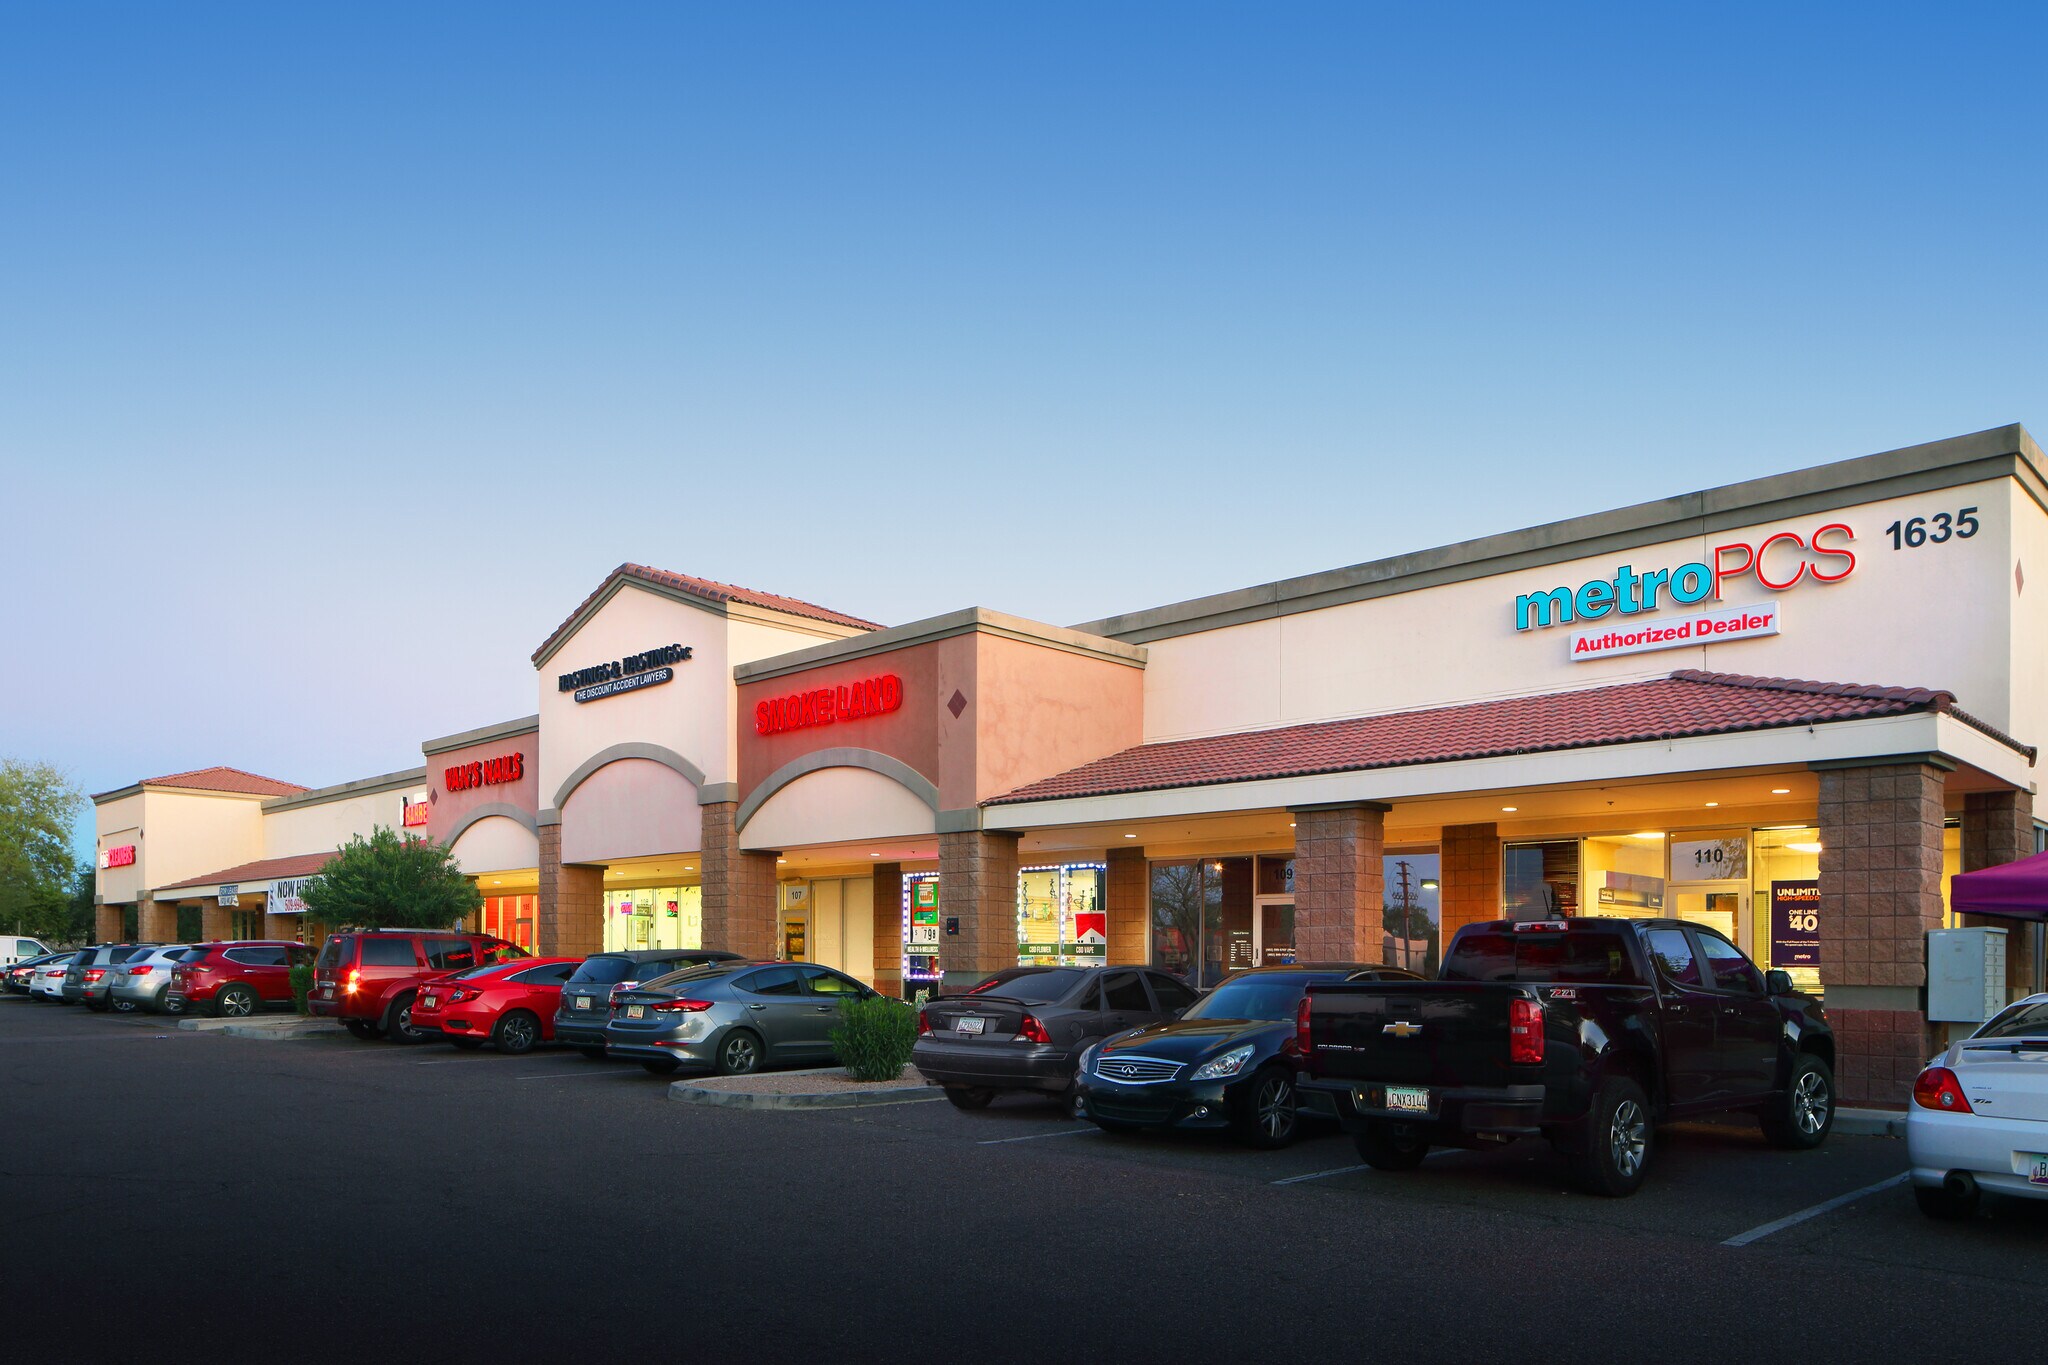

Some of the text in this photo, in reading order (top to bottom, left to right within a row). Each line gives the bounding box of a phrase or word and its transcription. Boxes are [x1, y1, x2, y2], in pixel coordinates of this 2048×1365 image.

[1886, 506, 1980, 550] 1635
[1516, 523, 1857, 630] metroPCS
[1574, 613, 1774, 653] Authorized Dealer
[558, 663, 611, 692] HASTINGS
[611, 661, 622, 678] &
[622, 643, 681, 675] HASTINGS
[576, 669, 668, 701] THE DISCOUNT ACCIDENT LAWYERS
[756, 675, 903, 735] SMOKE LAND
[484, 752, 524, 786] NAILS
[405, 802, 428, 826] BARBE
[1694, 848, 1724, 863] 110
[1274, 868, 1293, 880] 109
[277, 880, 295, 898] NOW
[791, 891, 802, 900] 107
[1777, 888, 1821, 896] UNLIMIT
[1084, 946, 1094, 954] VAPE
[1391, 1093, 1427, 1107] CNX3144
